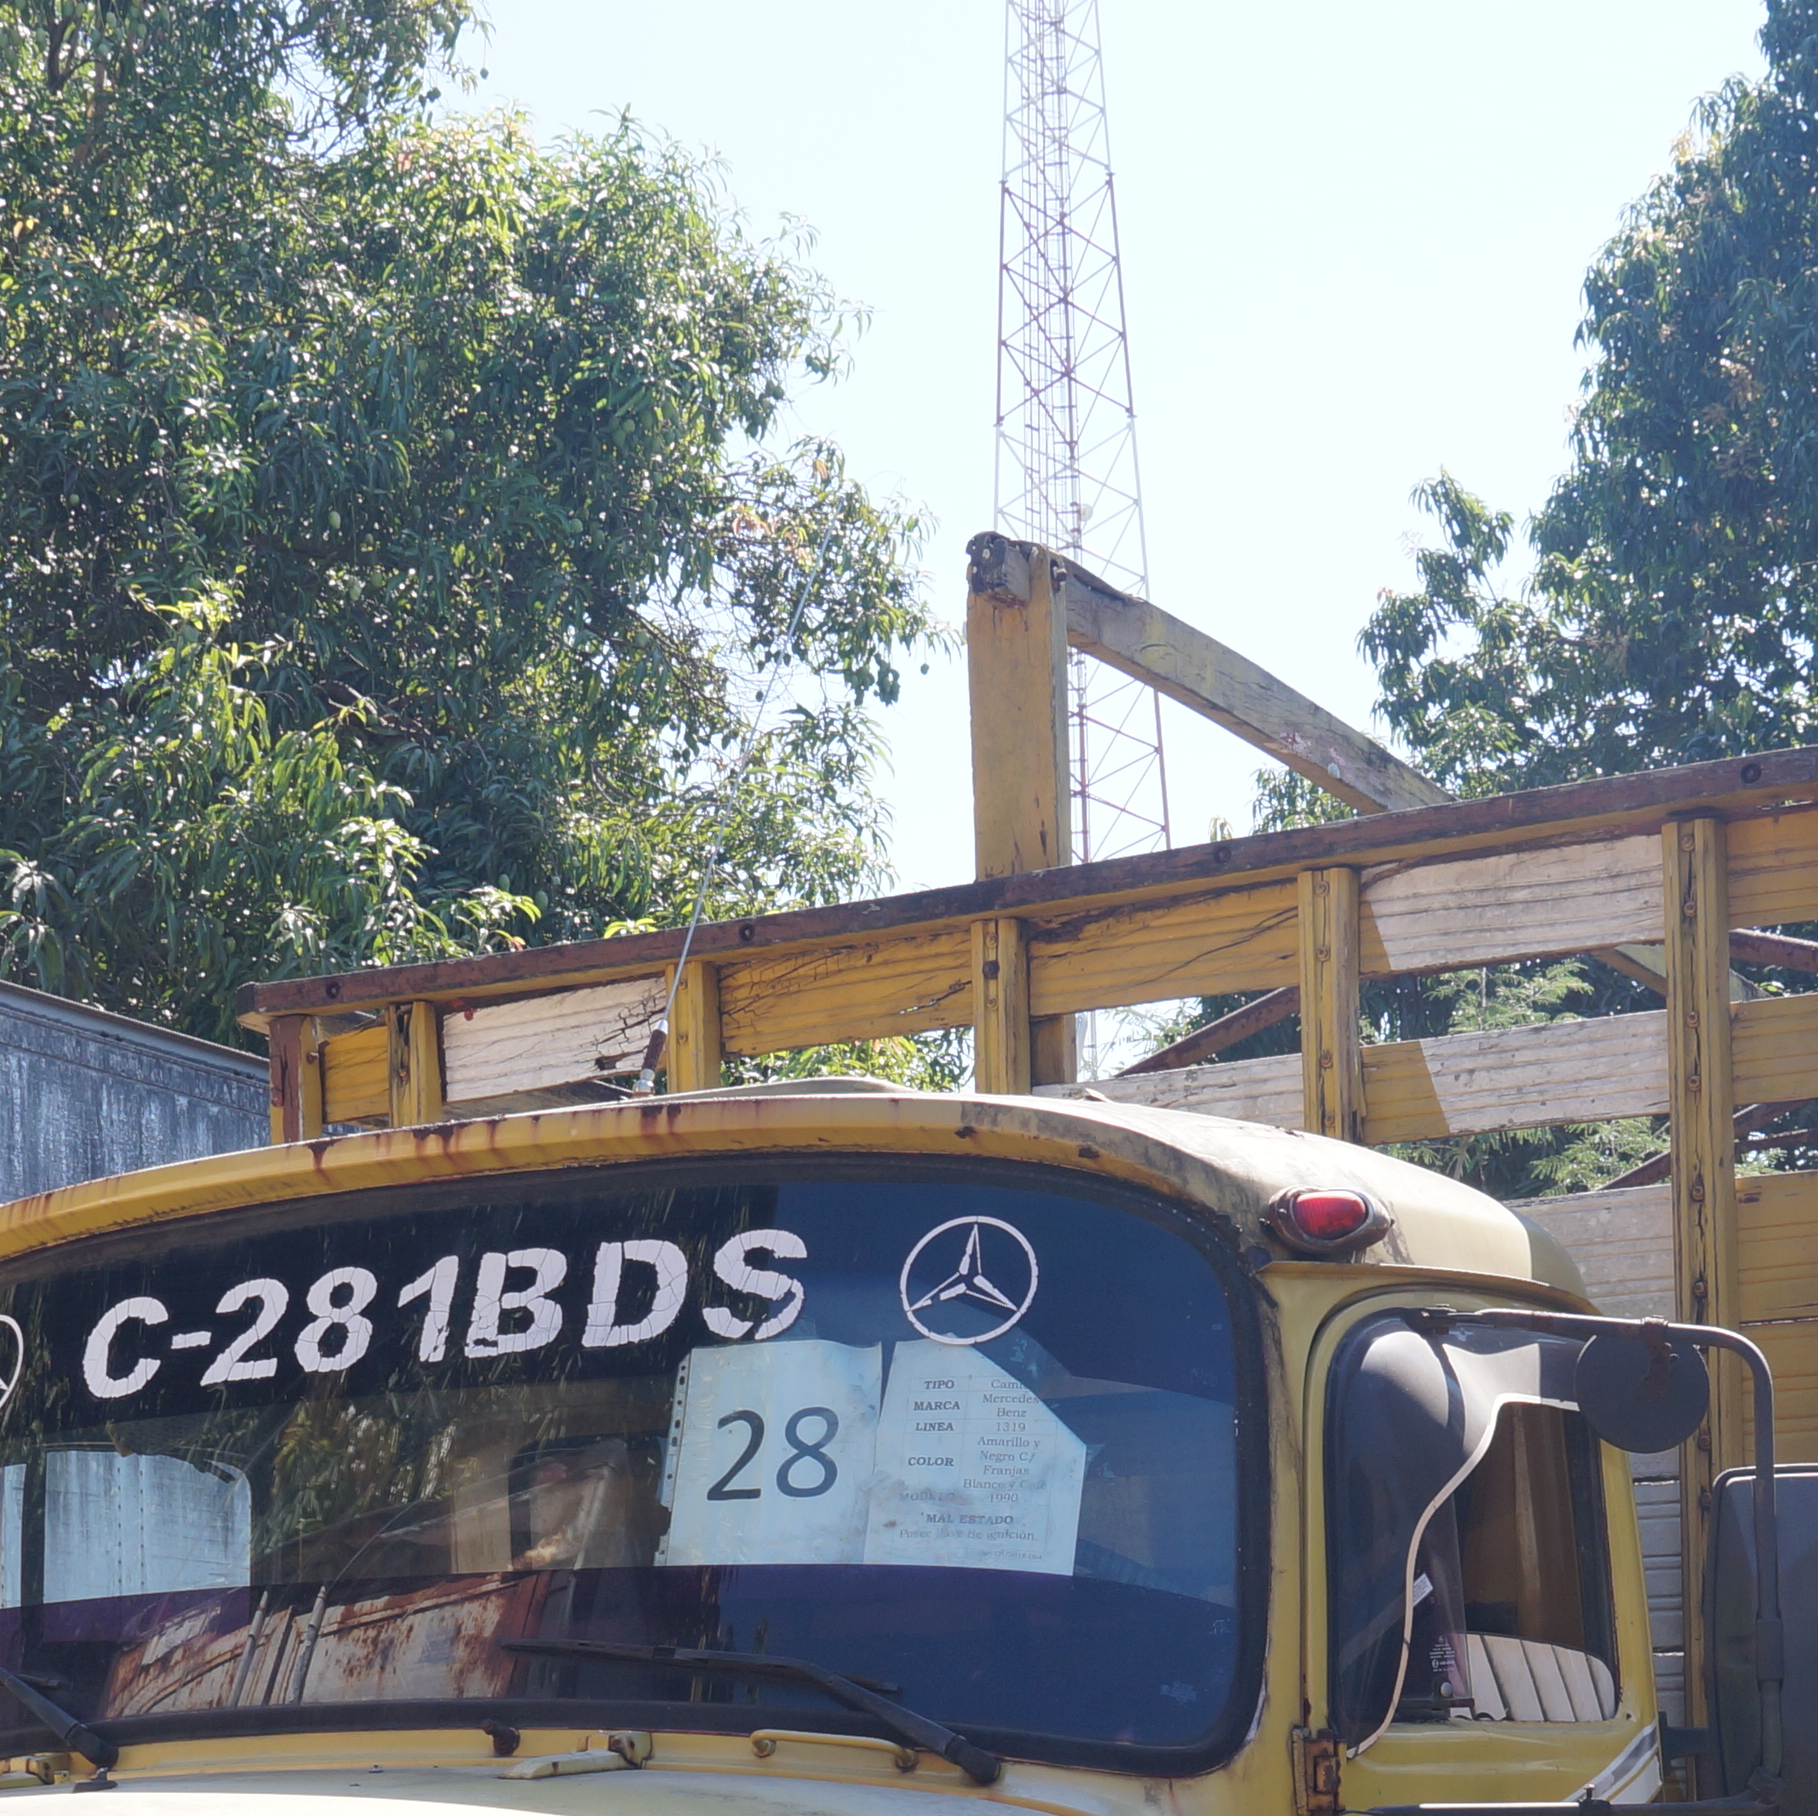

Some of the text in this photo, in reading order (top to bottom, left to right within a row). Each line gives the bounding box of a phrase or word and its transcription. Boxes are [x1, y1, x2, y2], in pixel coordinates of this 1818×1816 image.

[82, 1229, 808, 1399] C-281BDS
[924, 1380, 955, 1390] TIPO
[982, 1393, 1039, 1404] Mercedes
[913, 1401, 961, 1411] MARCA
[996, 1408, 1027, 1418] Benz
[915, 1422, 954, 1432] LINEA
[996, 1422, 1026, 1432] 1319
[977, 1436, 1041, 1449] Amarillo y
[706, 1406, 840, 1501] 28
[980, 1451, 1015, 1463] Negro
[908, 1457, 955, 1467] COLOR
[983, 1465, 1029, 1478] Franjas
[963, 1478, 1005, 1490] Blanco
[926, 1514, 1014, 1525] MAL ESTADO
